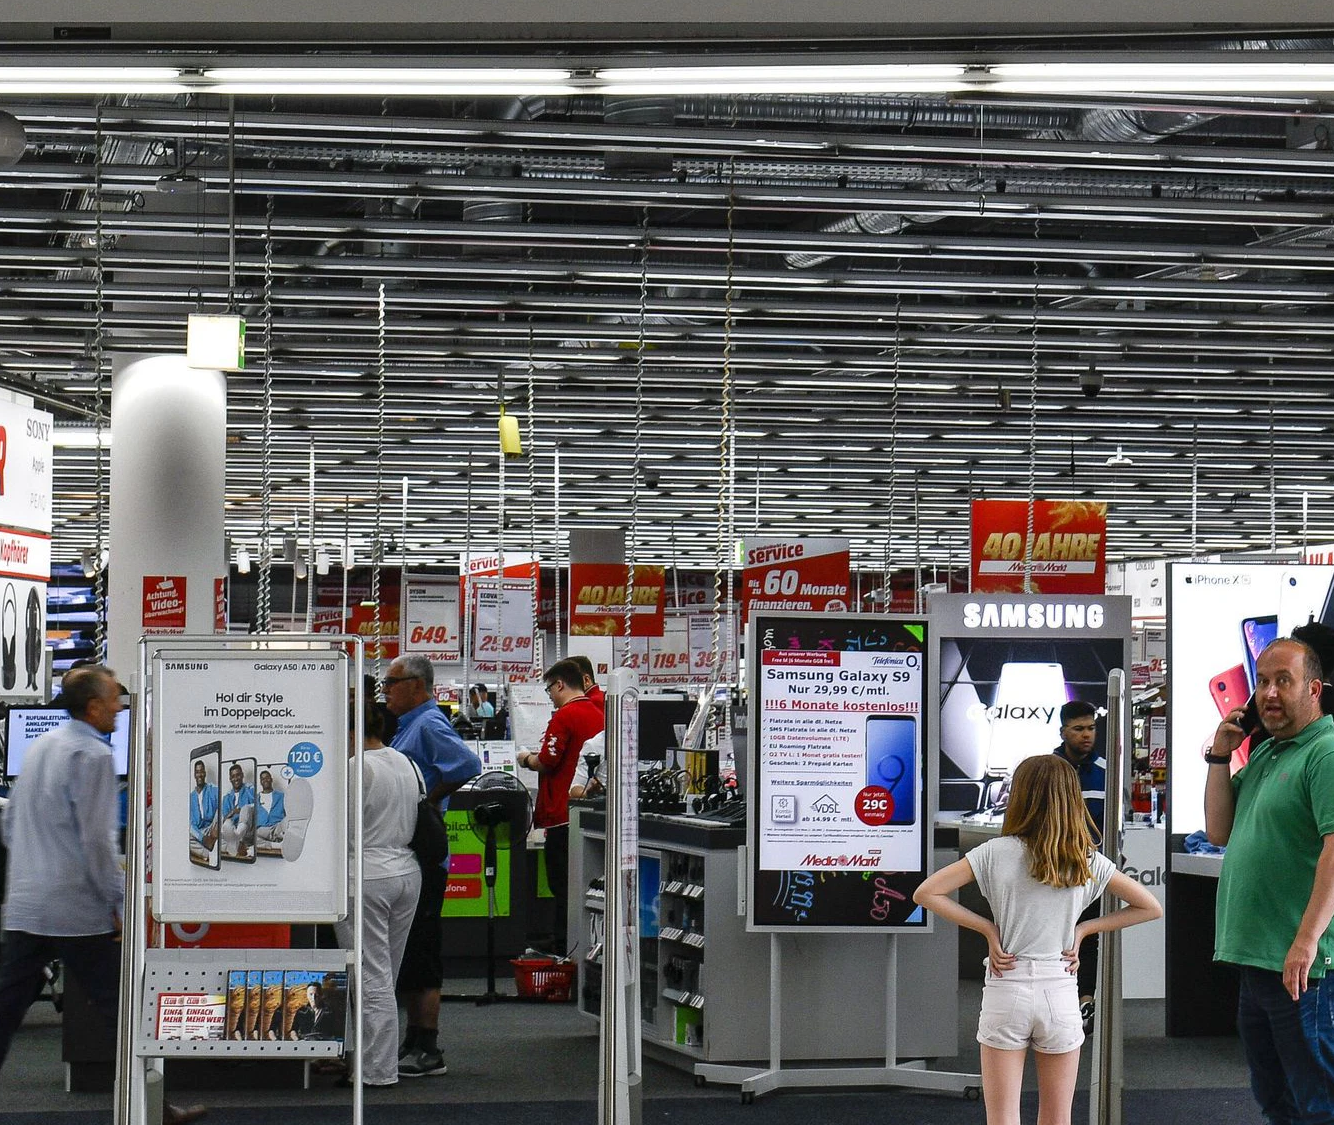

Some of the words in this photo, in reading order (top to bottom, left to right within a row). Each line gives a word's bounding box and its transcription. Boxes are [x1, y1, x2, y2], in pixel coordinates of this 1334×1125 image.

[27, 418, 50, 441] SONY
[0, 539, 28, 566] Kopfhörer
[982, 533, 1021, 560] 40
[749, 544, 803, 564] Service
[764, 570, 798, 595] 60
[800, 584, 846, 595] Monate
[1194, 575, 1230, 585] iPhone
[578, 586, 604, 604] 40
[748, 599, 812, 610] finanzieren.
[963, 603, 1104, 629] SAMSUNG
[872, 656, 904, 666] Telefónica
[254, 664, 281, 672] Galaxy
[767, 669, 833, 683] Samsung
[839, 670, 887, 684] Galaxy
[893, 672, 910, 682] S9
[788, 685, 810, 694] Nur
[814, 686, 847, 696] 29,99
[216, 693, 234, 702] Hol
[237, 693, 252, 702] dir
[255, 693, 283, 705] Style
[792, 700, 838, 710] Monate
[844, 701, 919, 712] kostenlos!!!
[204, 706, 218, 716] im
[221, 708, 295, 719] Doppelpack.
[290, 752, 310, 762] 120
[313, 752, 320, 762] €
[817, 804, 840, 813] VDSL
[863, 800, 888, 810] 29€
[800, 854, 838, 866] Media
[847, 854, 881, 866] Markt
